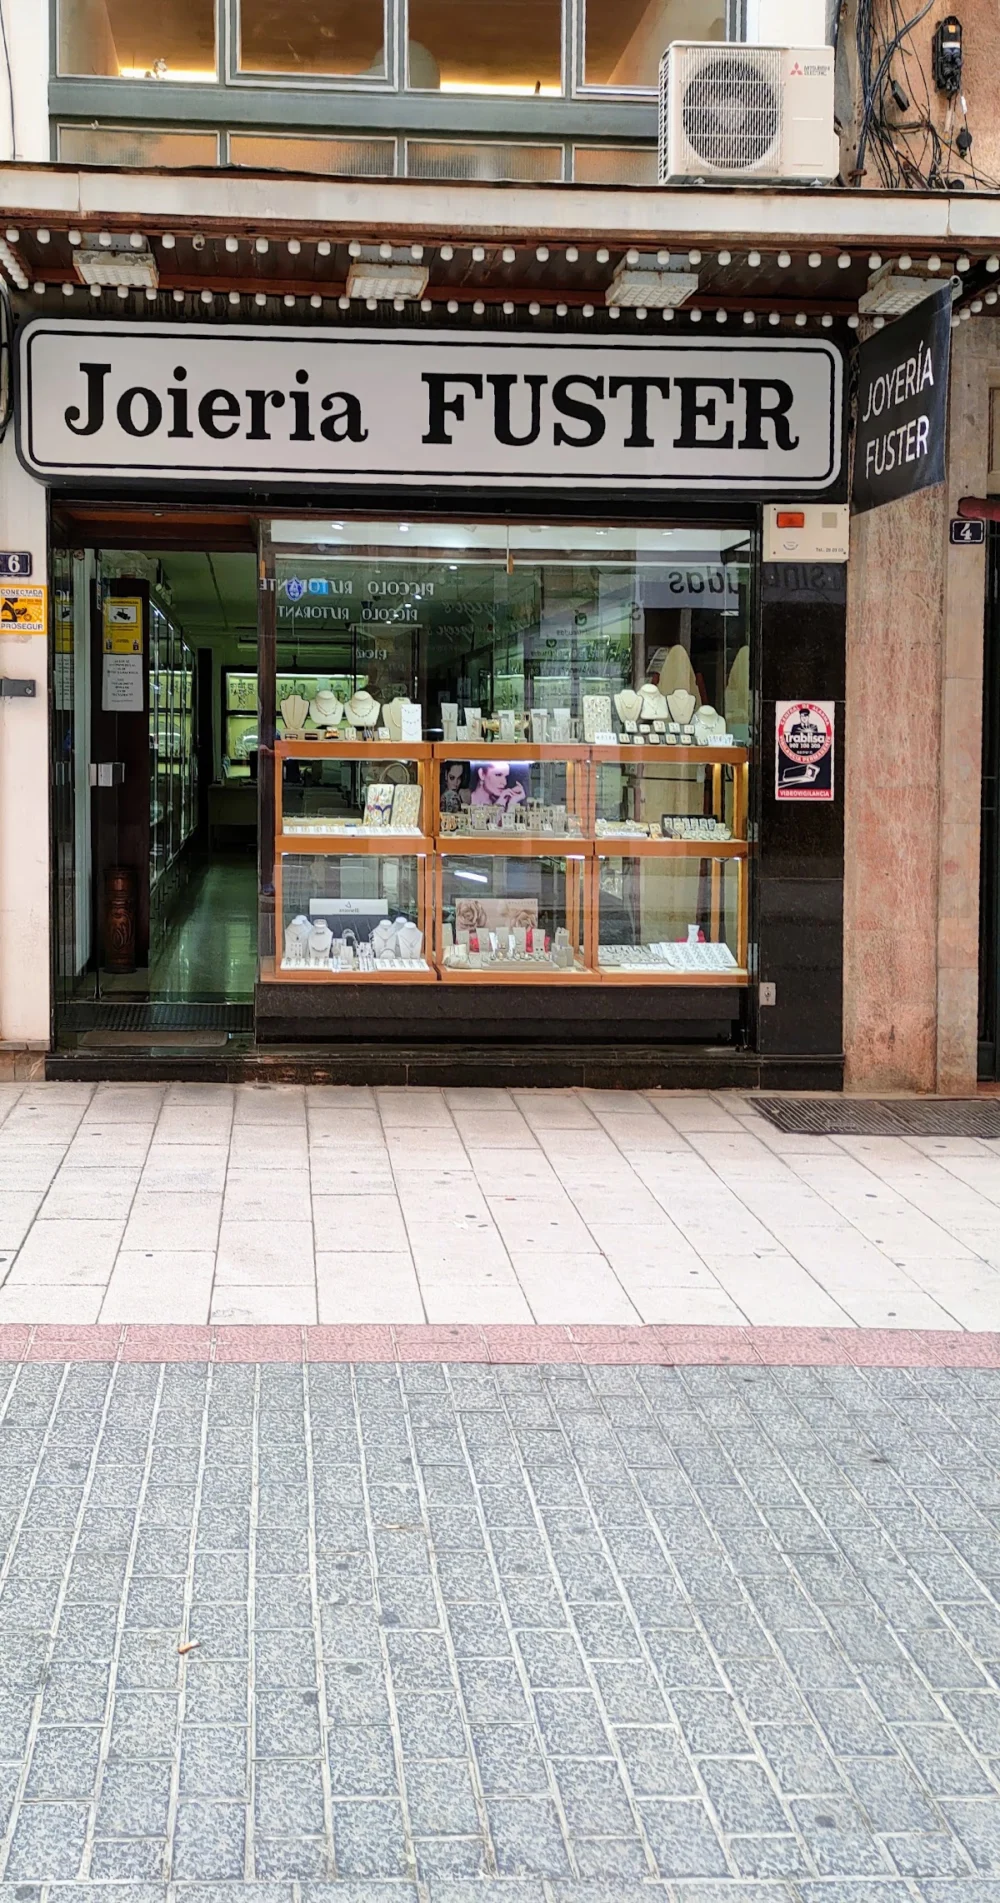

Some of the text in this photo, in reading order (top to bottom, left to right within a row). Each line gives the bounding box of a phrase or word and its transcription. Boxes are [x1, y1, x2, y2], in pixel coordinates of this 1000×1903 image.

[862, 340, 934, 422] JOYERÍA
[64, 362, 800, 451] Joieria FUSTER
[865, 414, 930, 480] FUSTER
[960, 522, 972, 540] 4
[8, 554, 20, 573] 6
[0, 588, 43, 596] CONECTADA
[784, 731, 825, 744] Trablisa
[780, 789, 830, 797] VIDEOVIGILANCIA
